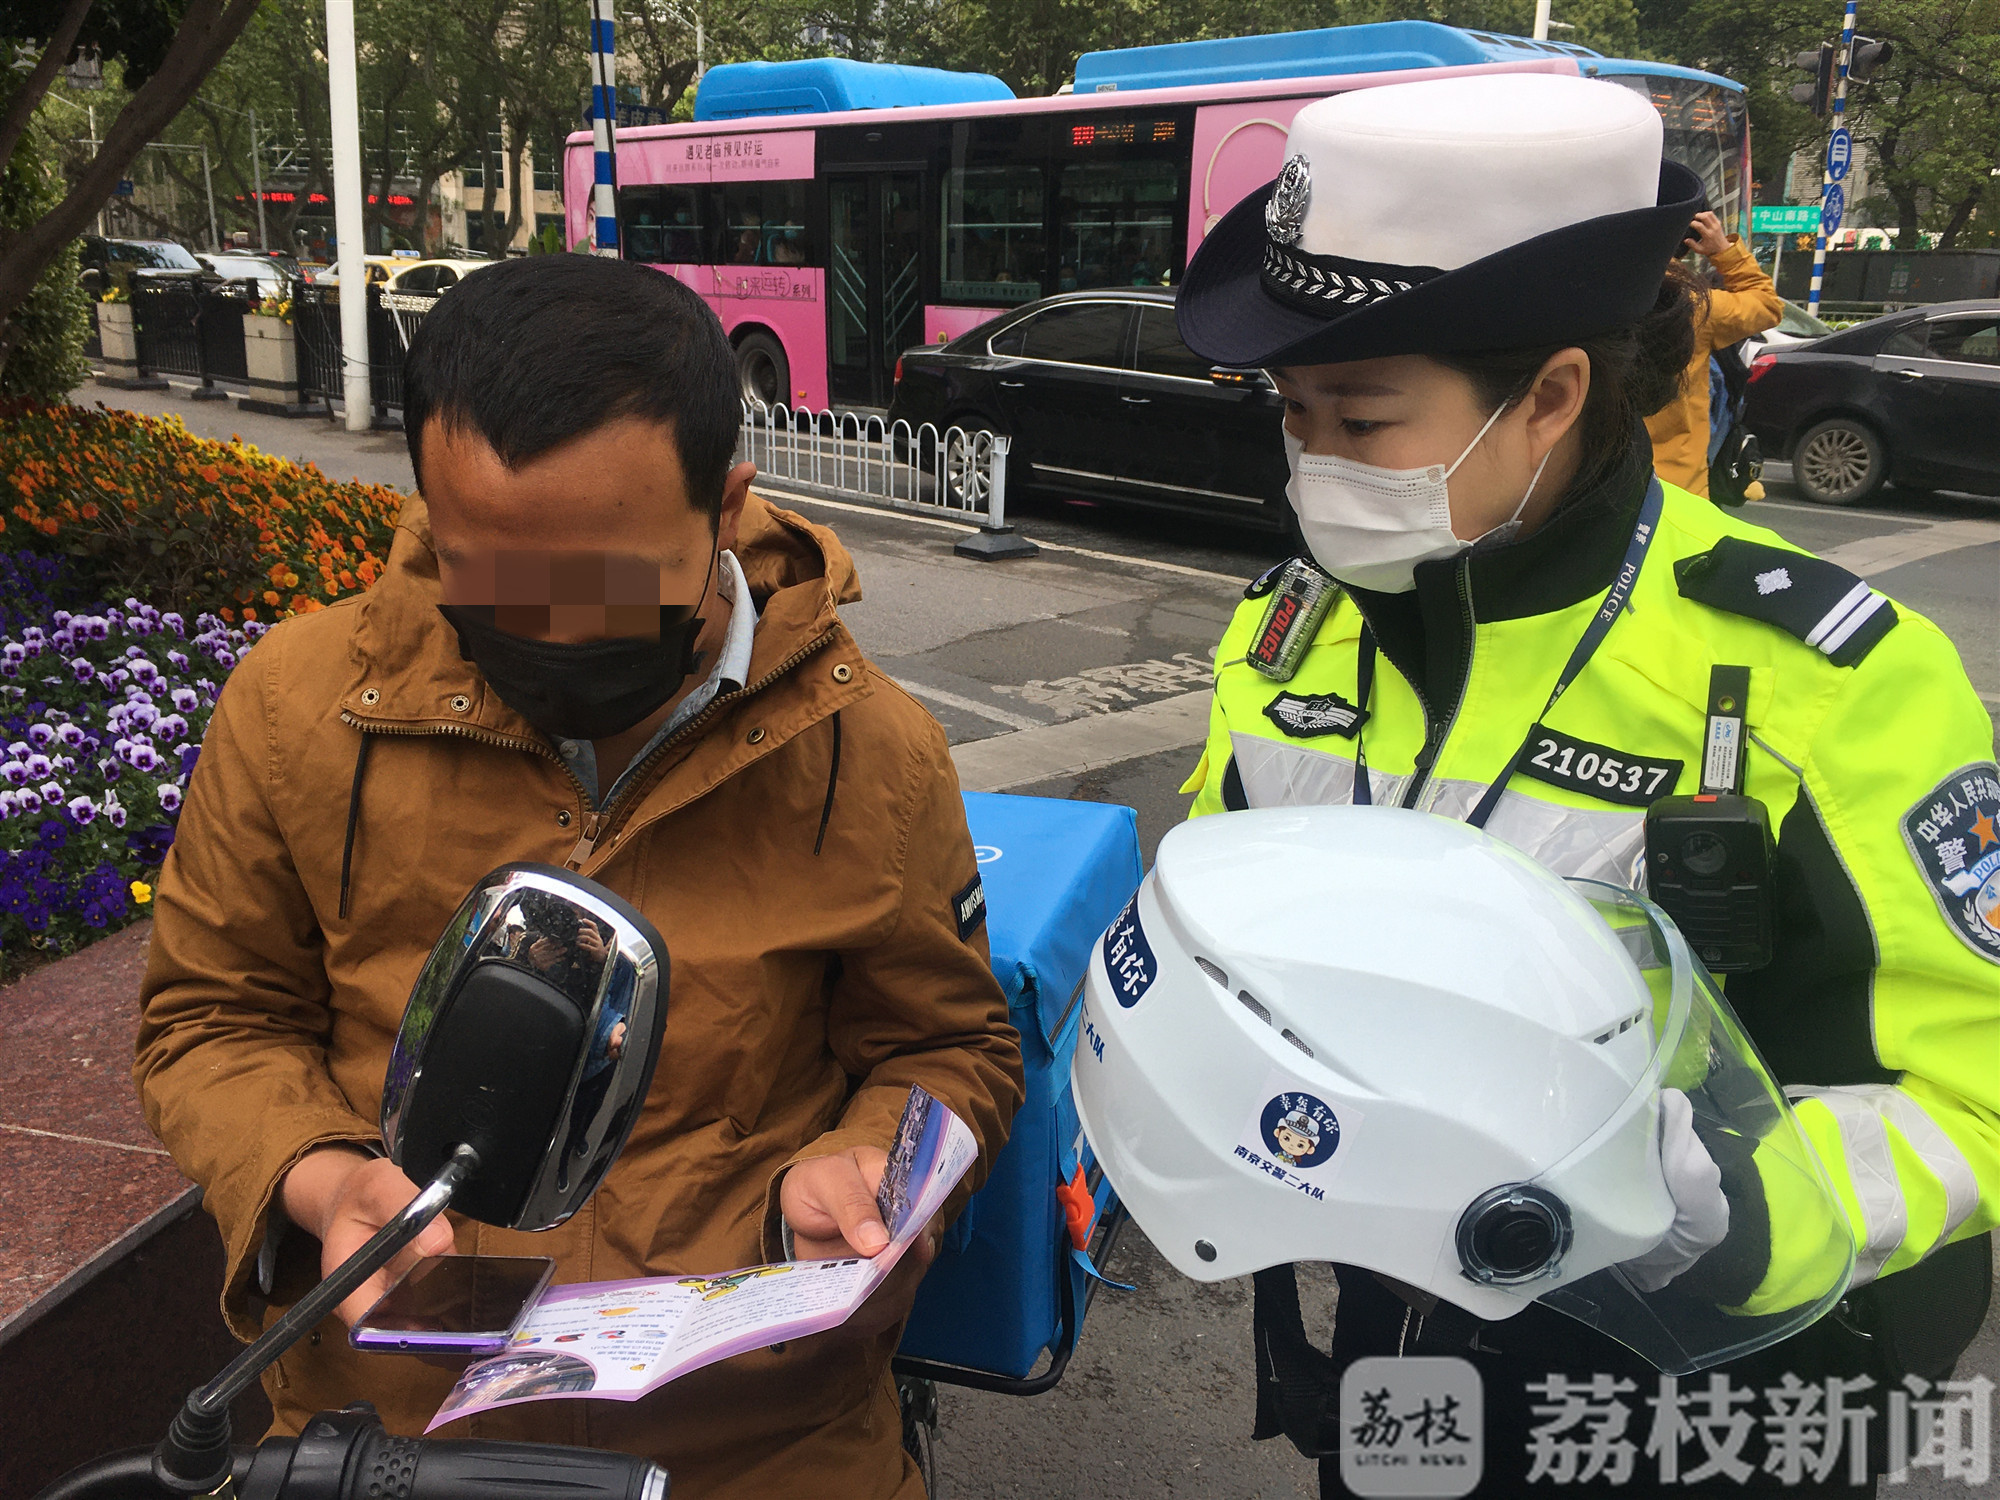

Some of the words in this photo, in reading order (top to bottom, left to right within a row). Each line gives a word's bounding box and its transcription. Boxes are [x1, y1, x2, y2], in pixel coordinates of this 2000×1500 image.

[685, 140, 764, 161] 遇见老庙预见好运
[1760, 209, 1809, 222] 中山南路
[1599, 562, 1637, 622] POLICE
[1258, 596, 1297, 663] POLICE
[1530, 738, 1669, 796] 210537
[1233, 1144, 1326, 1201] 南京交警二大队
